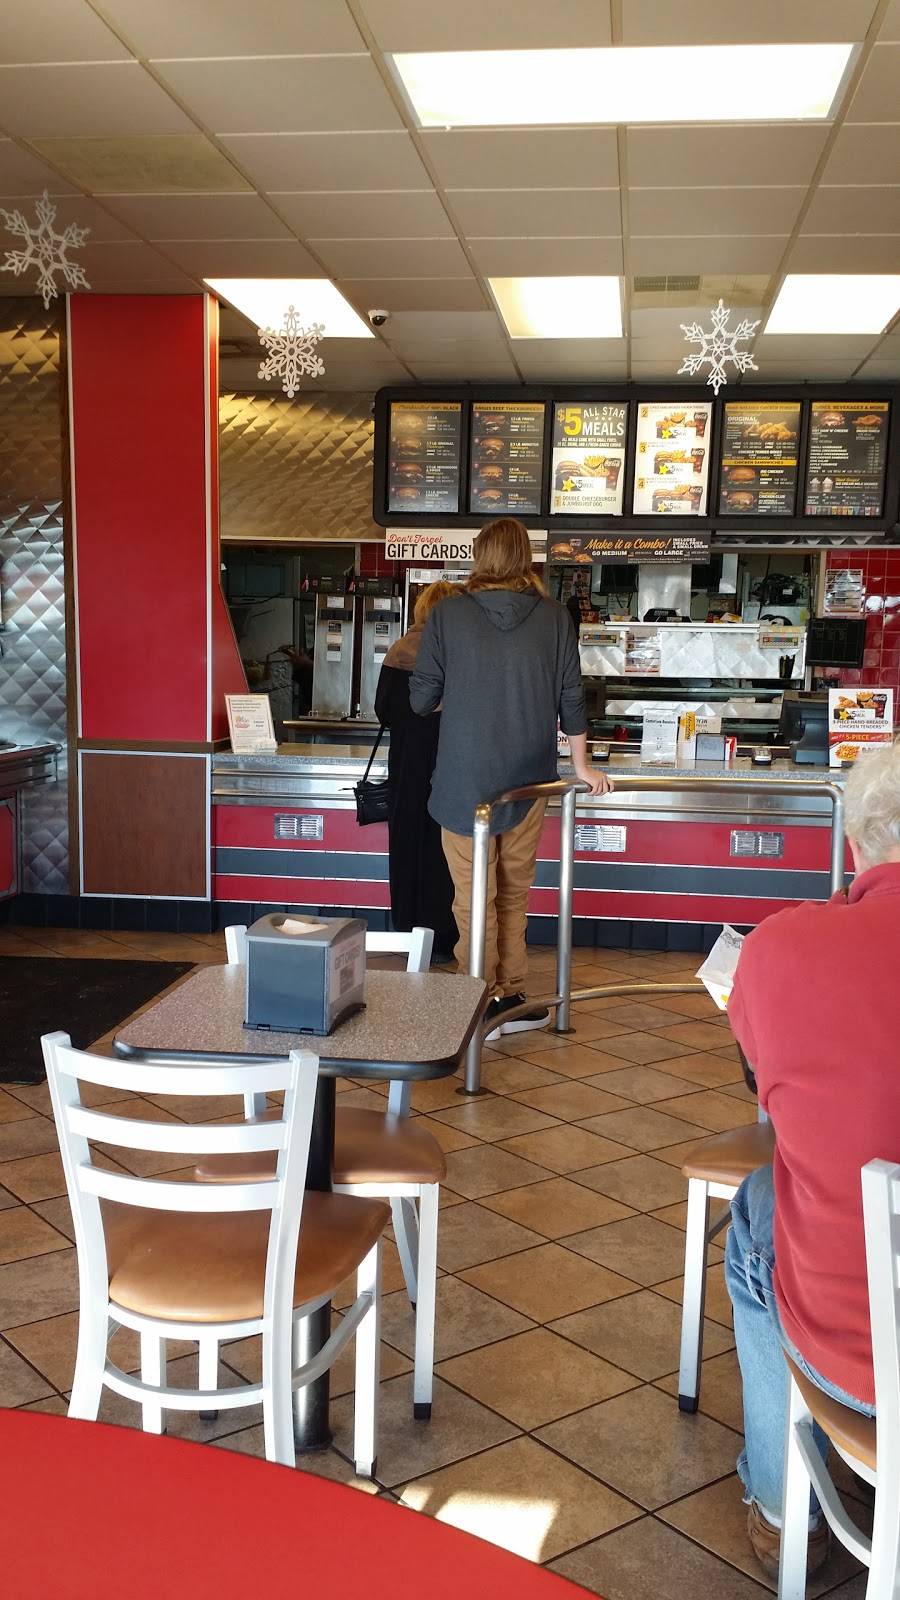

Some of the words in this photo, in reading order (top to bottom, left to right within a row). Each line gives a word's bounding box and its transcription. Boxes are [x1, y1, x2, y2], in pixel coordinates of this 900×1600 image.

[583, 407, 600, 419] ALL
[602, 406, 625, 420] STAR
[582, 421, 625, 437] MEALS
[388, 533, 413, 543] Don't
[414, 534, 444, 545] Forget
[584, 538, 614, 550] Make
[614, 539, 624, 550] it
[633, 538, 672, 549] Combo!
[387, 543, 418, 558] GIFT
[421, 544, 472, 559] CARDS!
